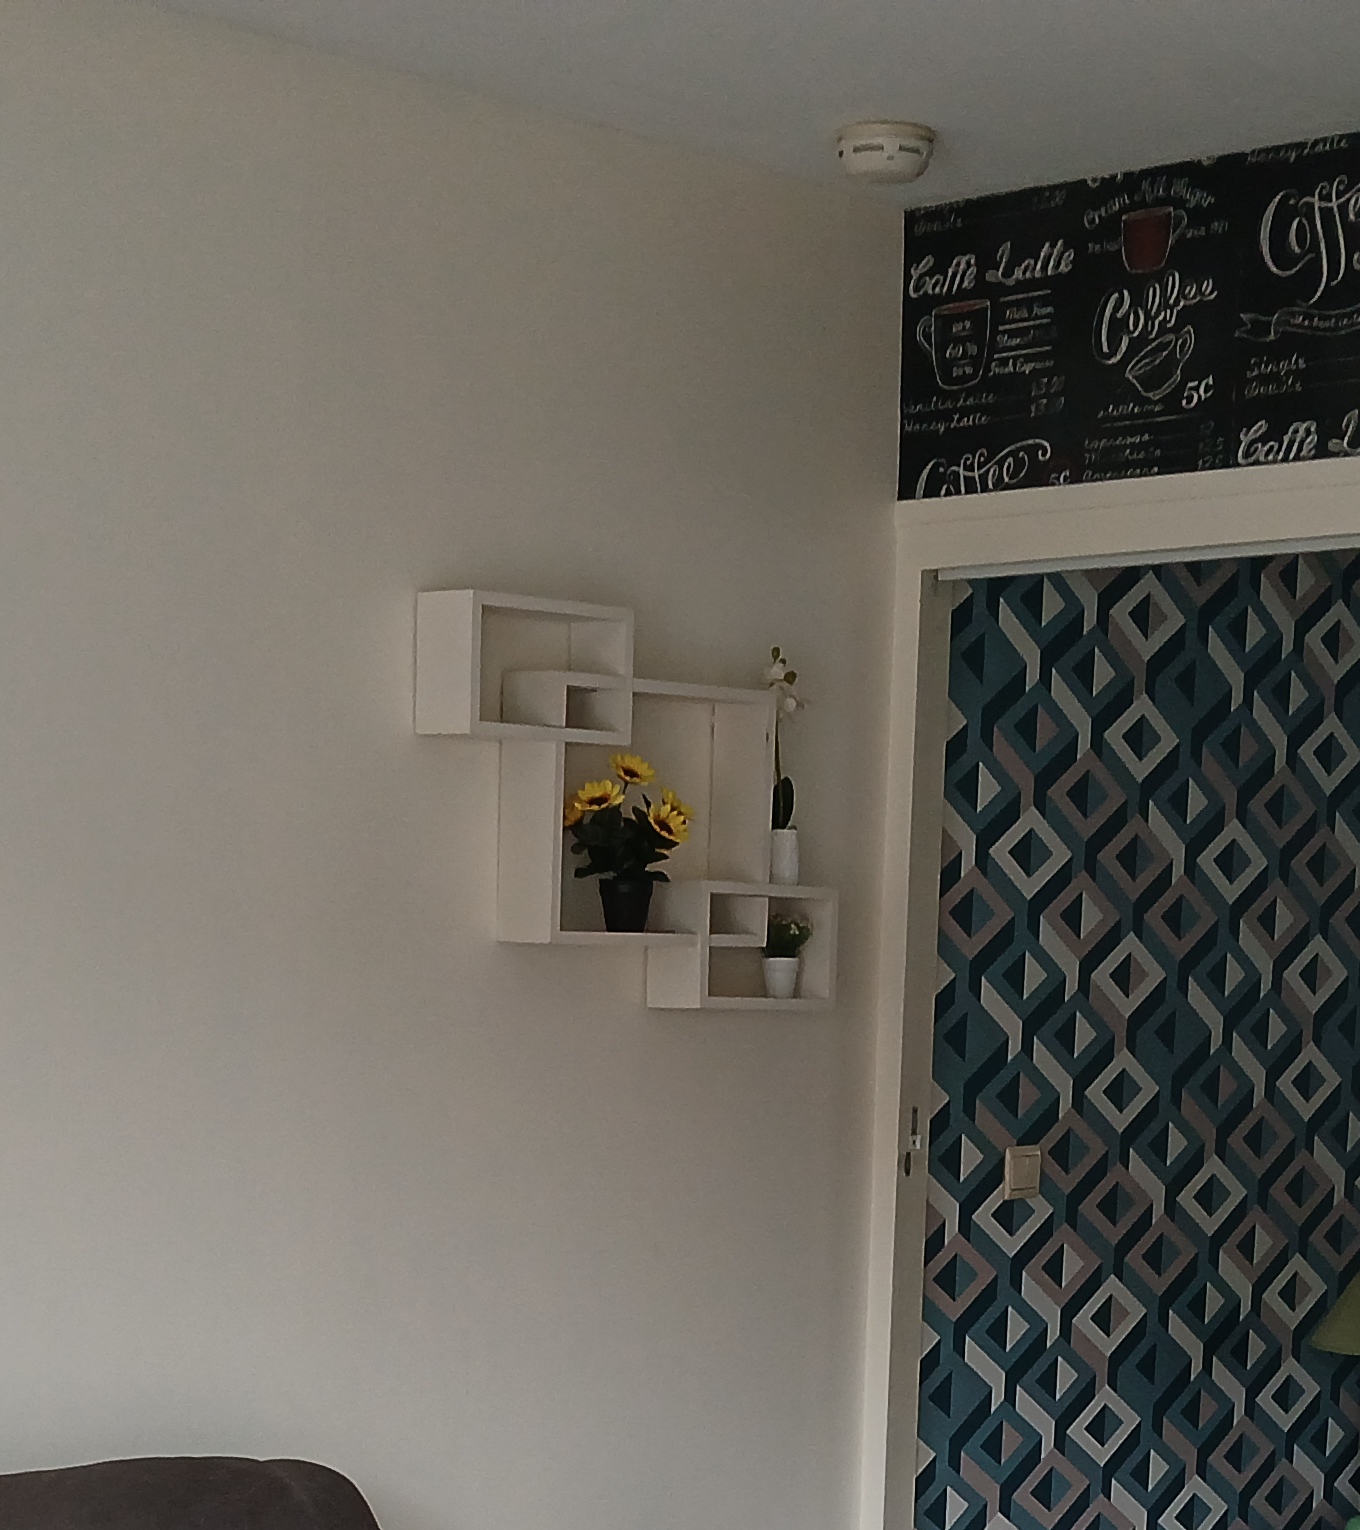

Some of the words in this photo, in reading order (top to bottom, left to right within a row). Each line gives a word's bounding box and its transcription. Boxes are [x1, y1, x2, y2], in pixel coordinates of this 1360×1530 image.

[985, 239, 1075, 286] Latte
[1092, 269, 1217, 365] Coffee
[1181, 375, 1214, 409] 5¢
